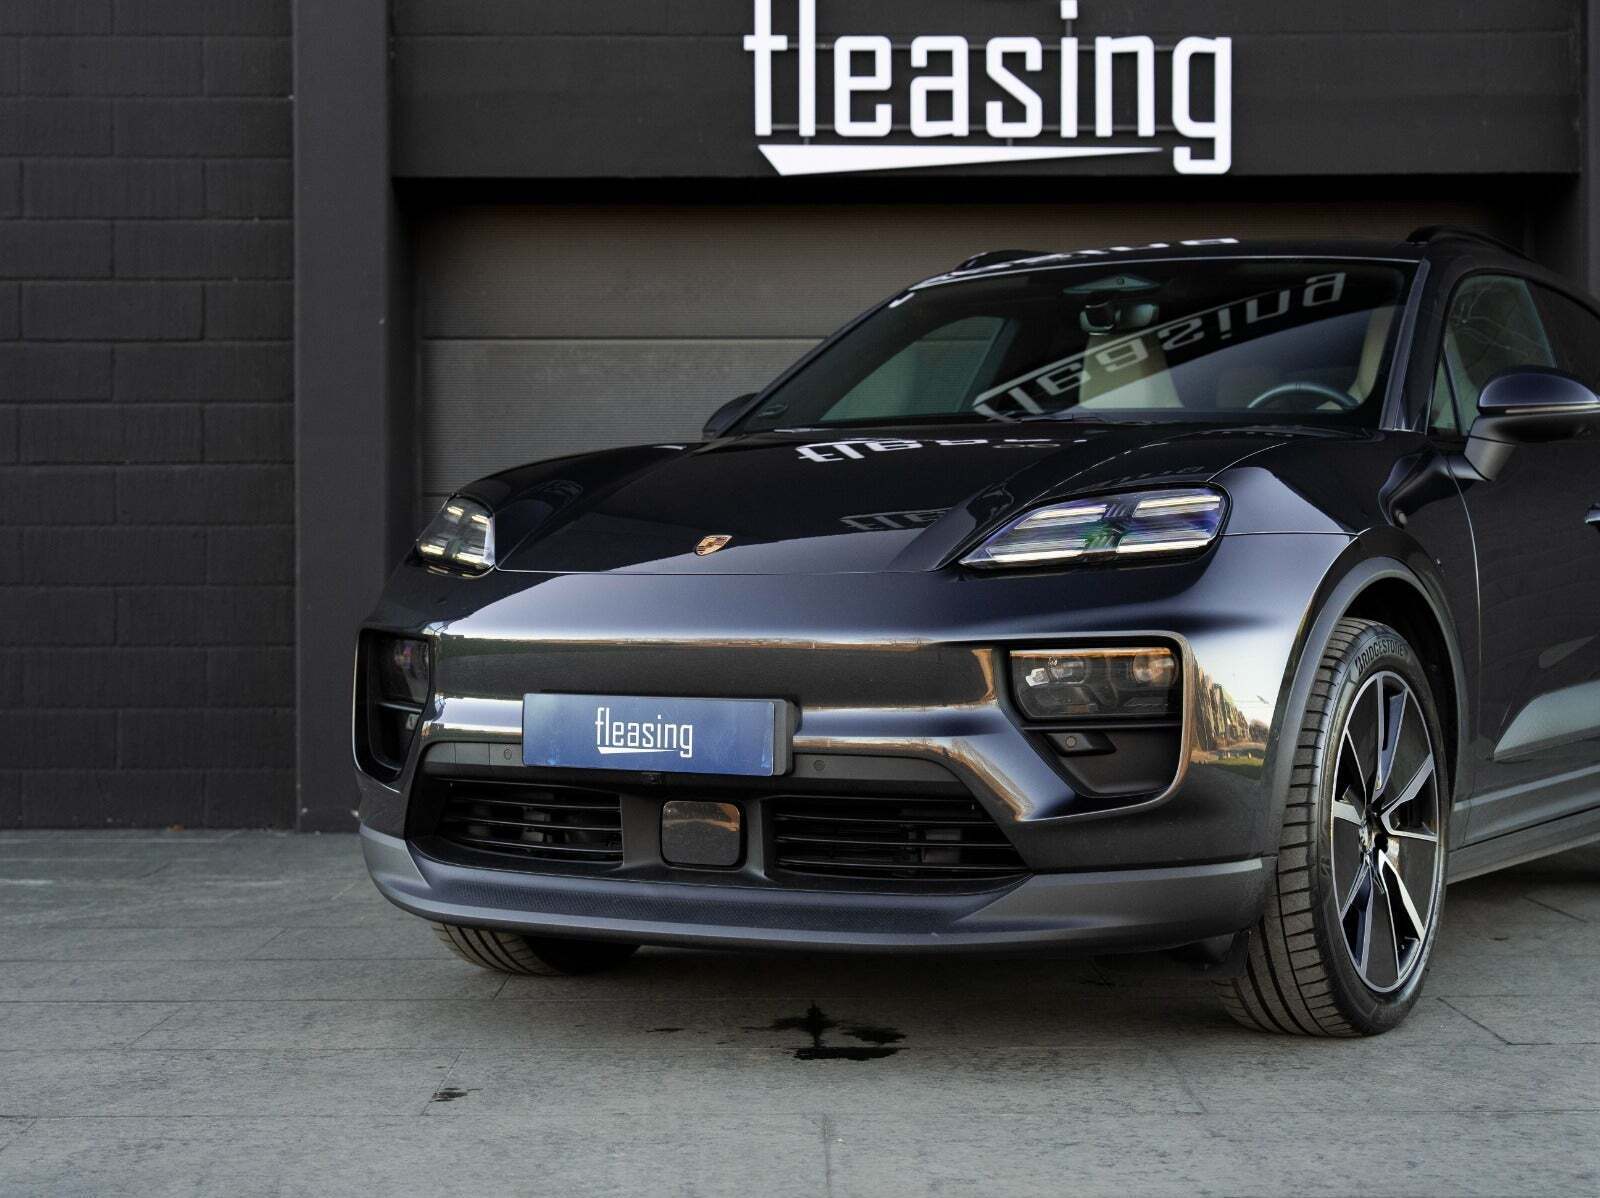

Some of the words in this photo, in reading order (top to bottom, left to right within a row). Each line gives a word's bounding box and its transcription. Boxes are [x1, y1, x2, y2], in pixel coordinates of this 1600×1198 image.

[743, 0, 1232, 174] fleasing
[1354, 639, 1406, 677] BRIDGESTONE
[595, 707, 693, 758] fleasing
